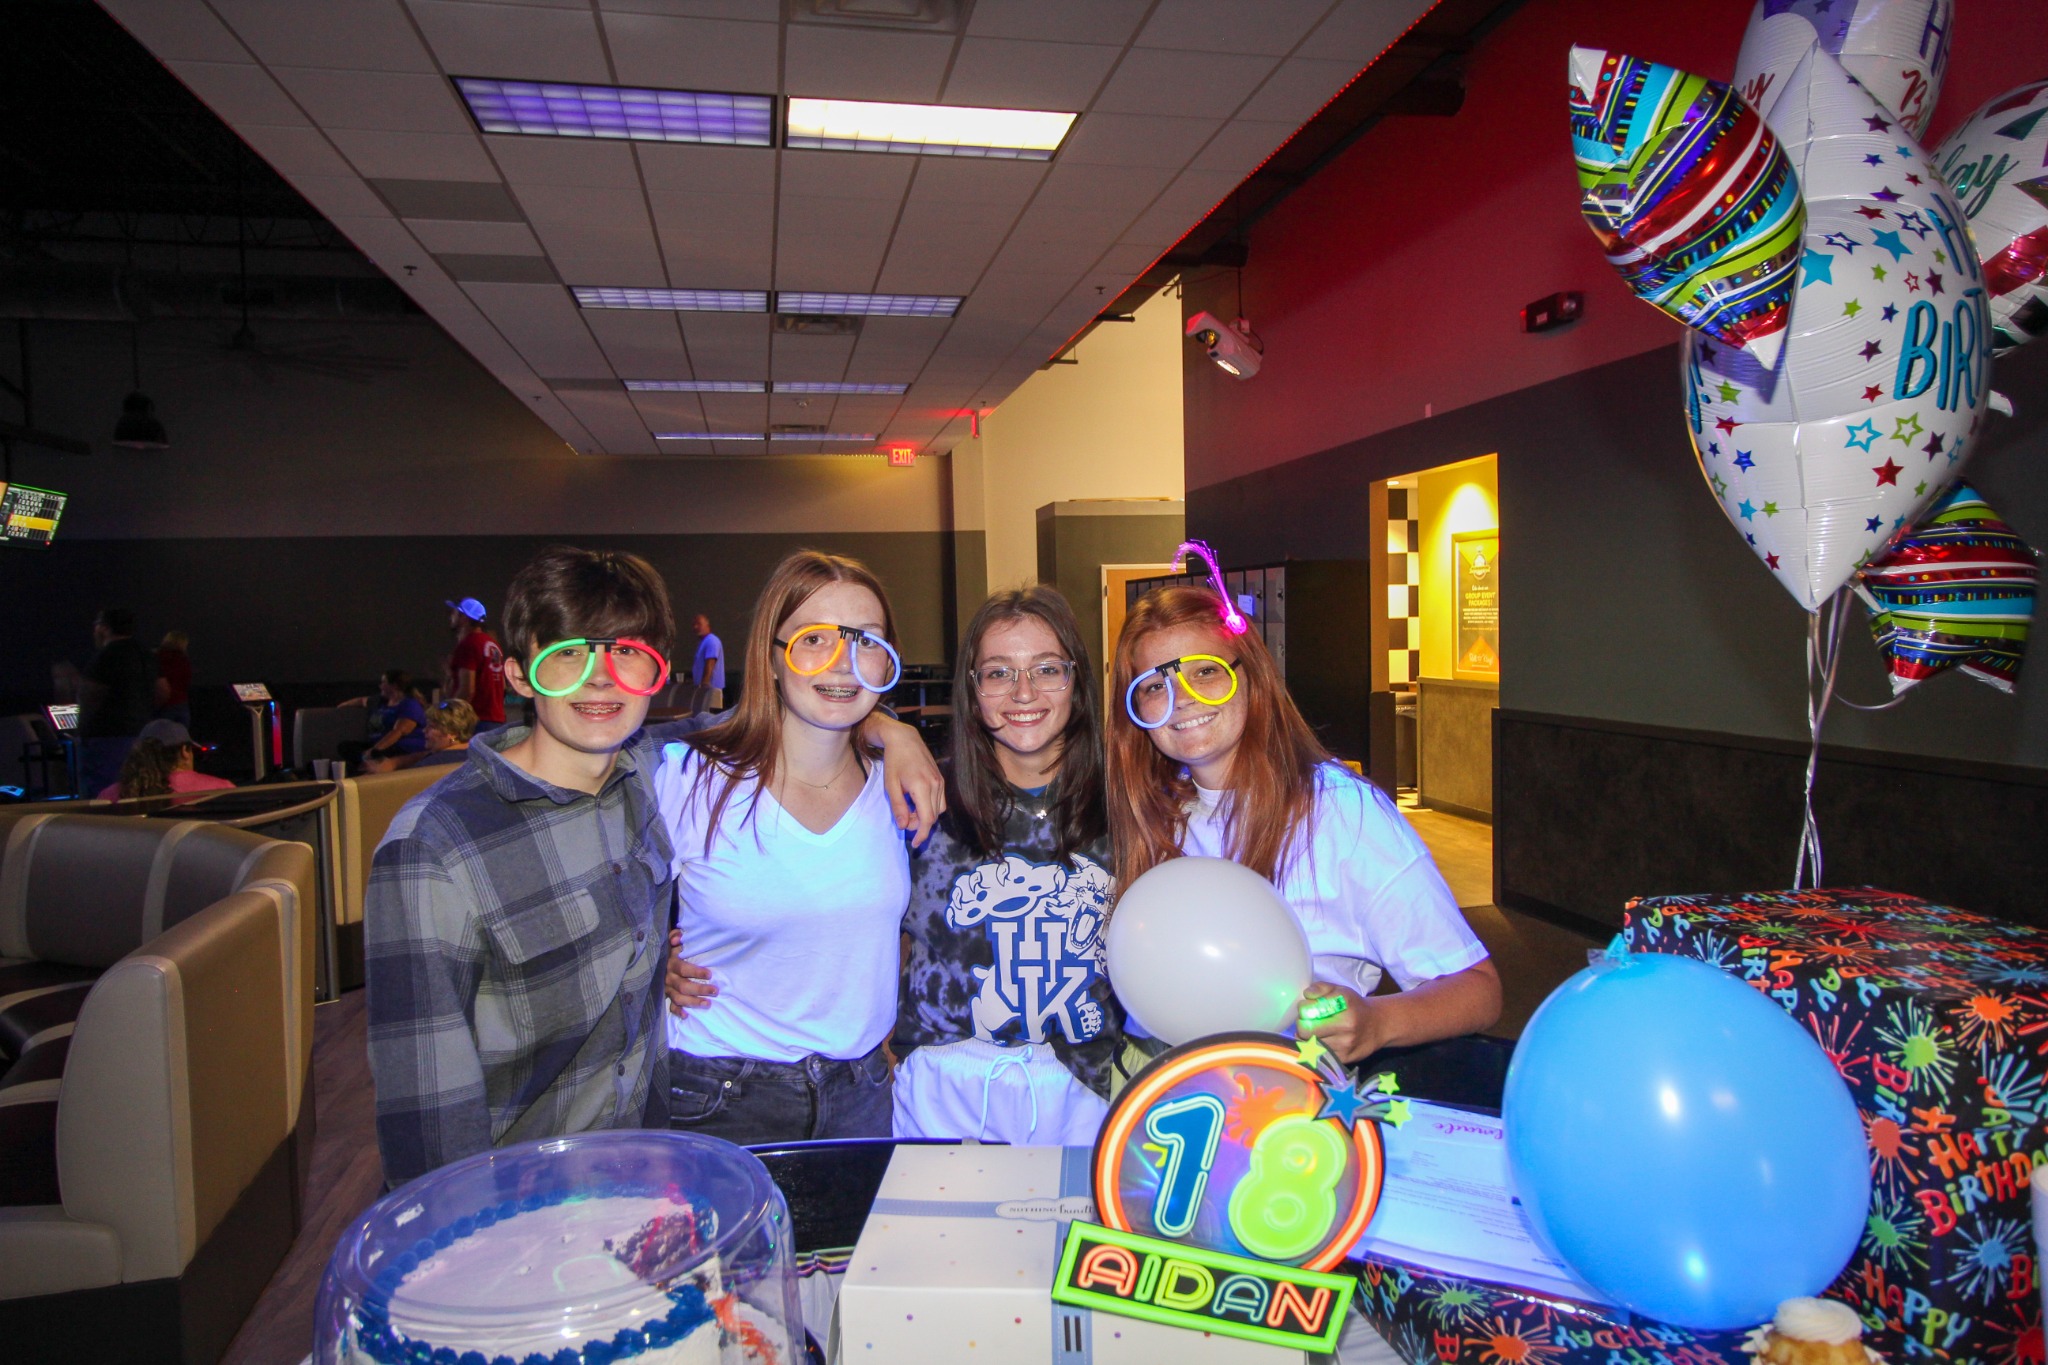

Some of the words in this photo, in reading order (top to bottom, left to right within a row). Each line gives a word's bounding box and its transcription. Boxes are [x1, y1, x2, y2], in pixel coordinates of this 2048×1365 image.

[892, 448, 913, 464] EXIT
[1145, 1091, 1347, 1260] 18
[1078, 1245, 1331, 1334] AIDAN
[1861, 1258, 1971, 1350] HAPPY
